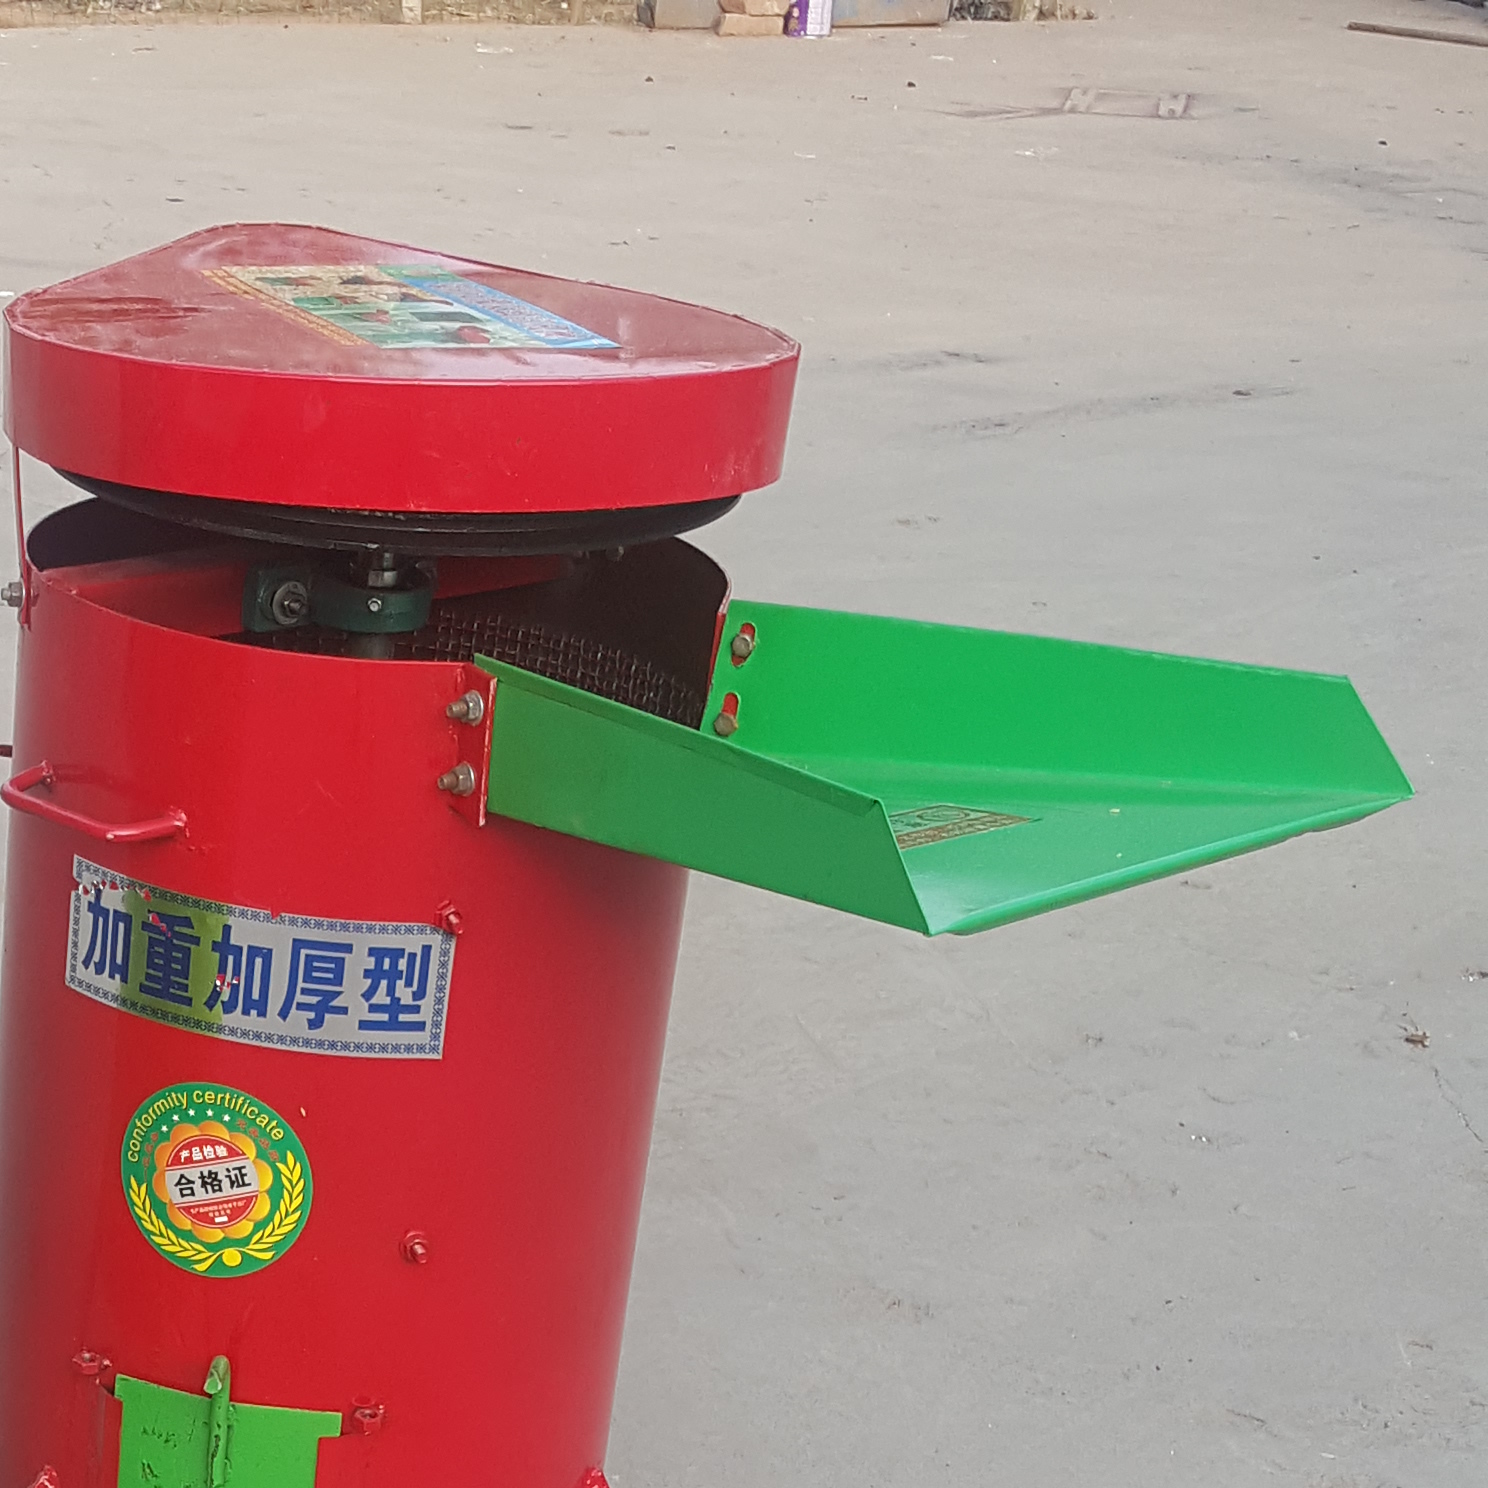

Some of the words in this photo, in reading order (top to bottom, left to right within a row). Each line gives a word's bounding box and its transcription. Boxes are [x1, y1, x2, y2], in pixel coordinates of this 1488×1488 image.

[81, 886, 433, 1033] 加重加厚型
[127, 1091, 189, 1163] conformity
[192, 1090, 285, 1142] certificate
[179, 1145, 229, 1163] 产品检验
[173, 1165, 252, 1198] 合格证
